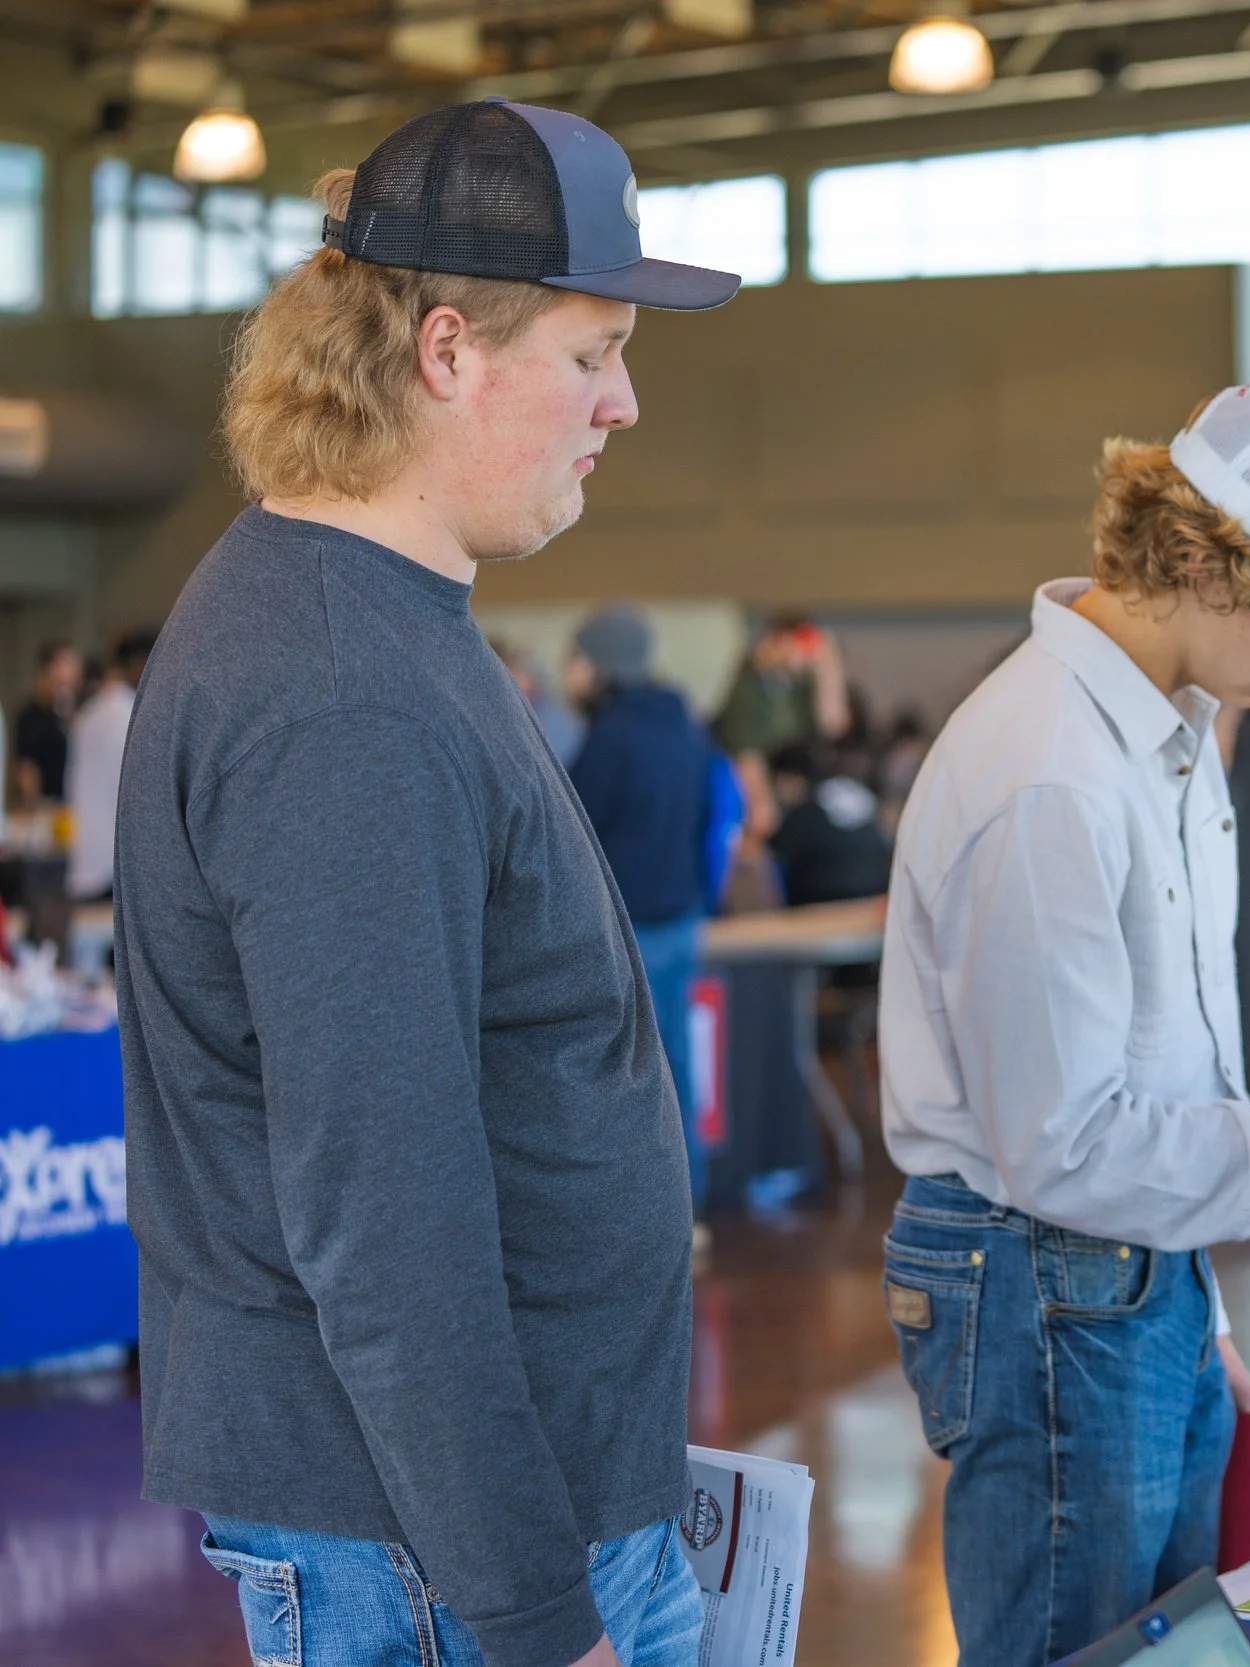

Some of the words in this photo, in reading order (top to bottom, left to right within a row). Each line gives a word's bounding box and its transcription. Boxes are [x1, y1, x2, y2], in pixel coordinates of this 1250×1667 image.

[695, 1493, 708, 1544] BYARD
[759, 1566, 781, 1666] jobs.unitedrentals.com
[782, 1583, 794, 1618] United
[776, 1620, 789, 1658] Rentals
